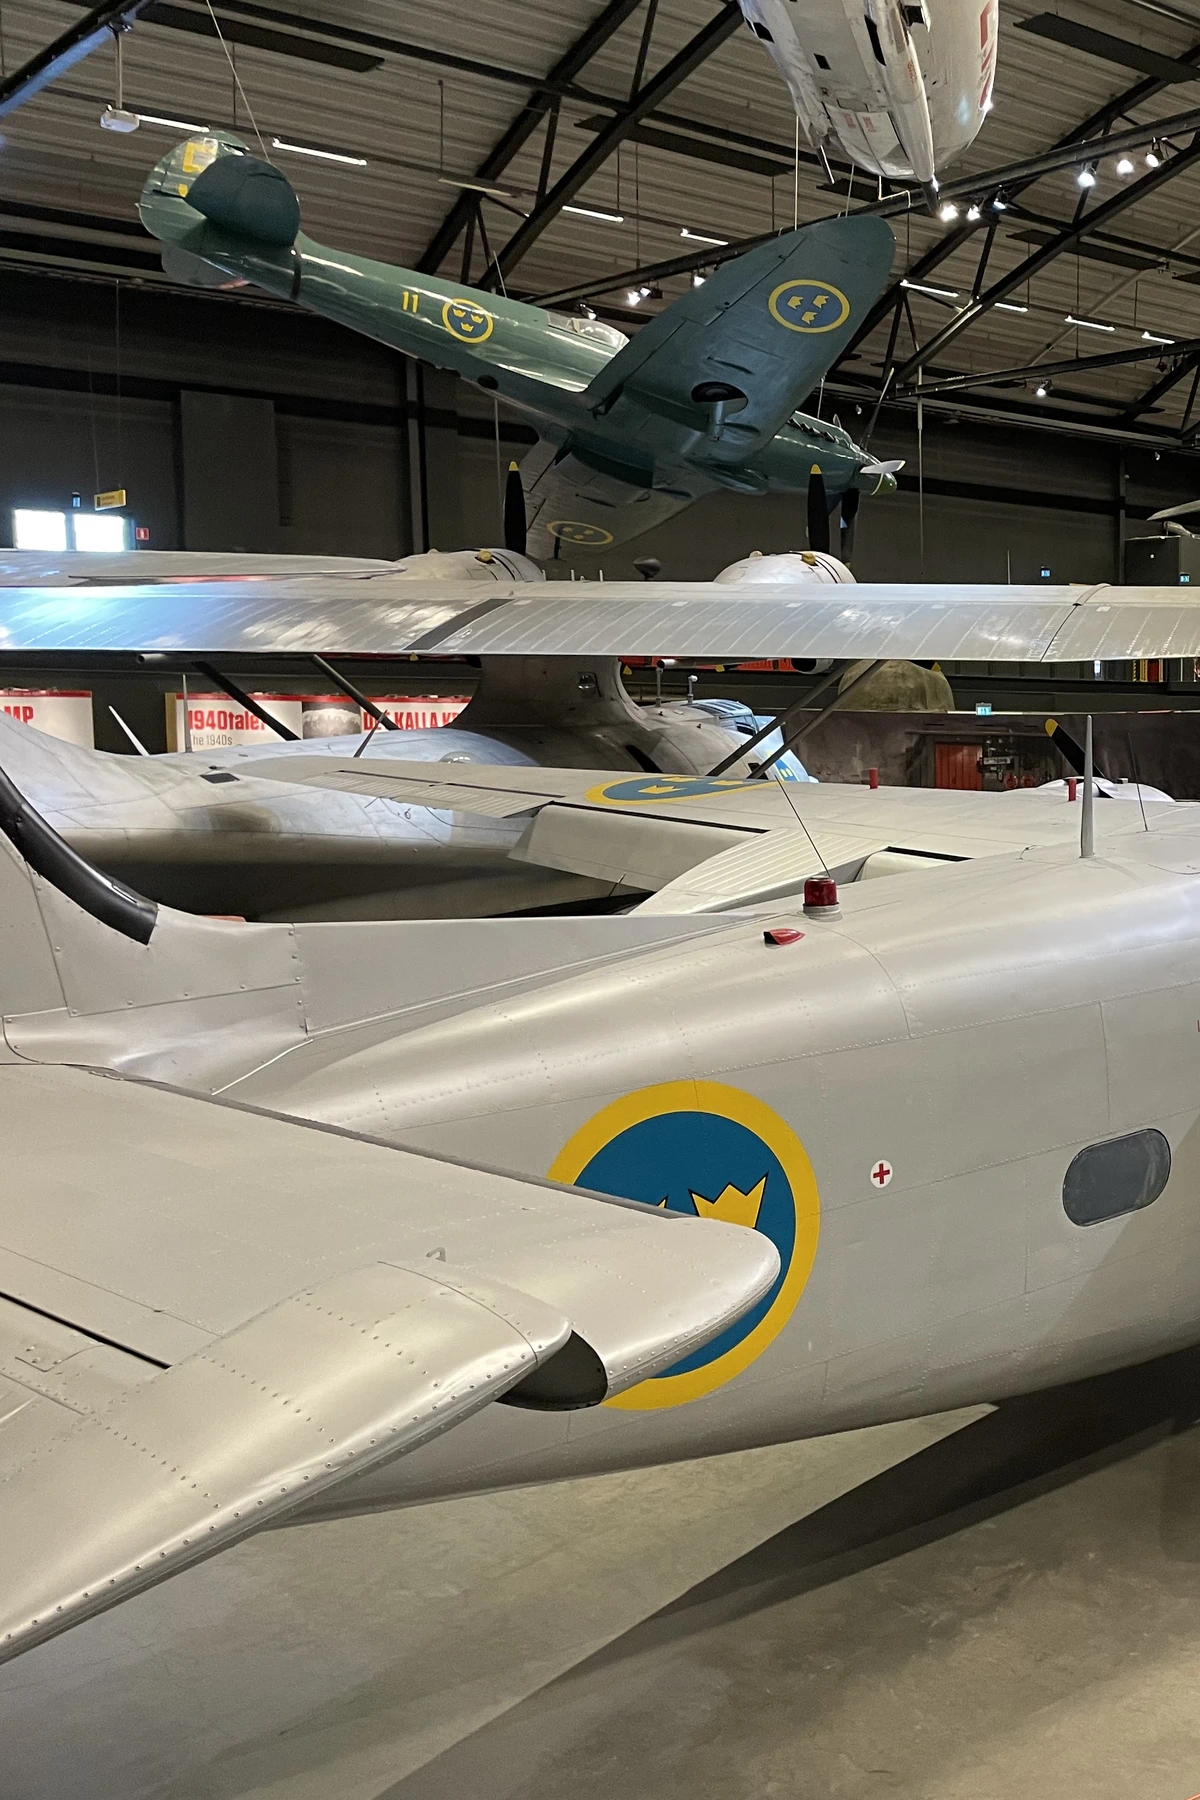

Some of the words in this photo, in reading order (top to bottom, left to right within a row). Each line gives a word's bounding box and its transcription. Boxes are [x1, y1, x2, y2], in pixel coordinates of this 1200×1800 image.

[402, 291, 418, 314] 11
[192, 735, 204, 746] he
[206, 735, 233, 746] 1940s
